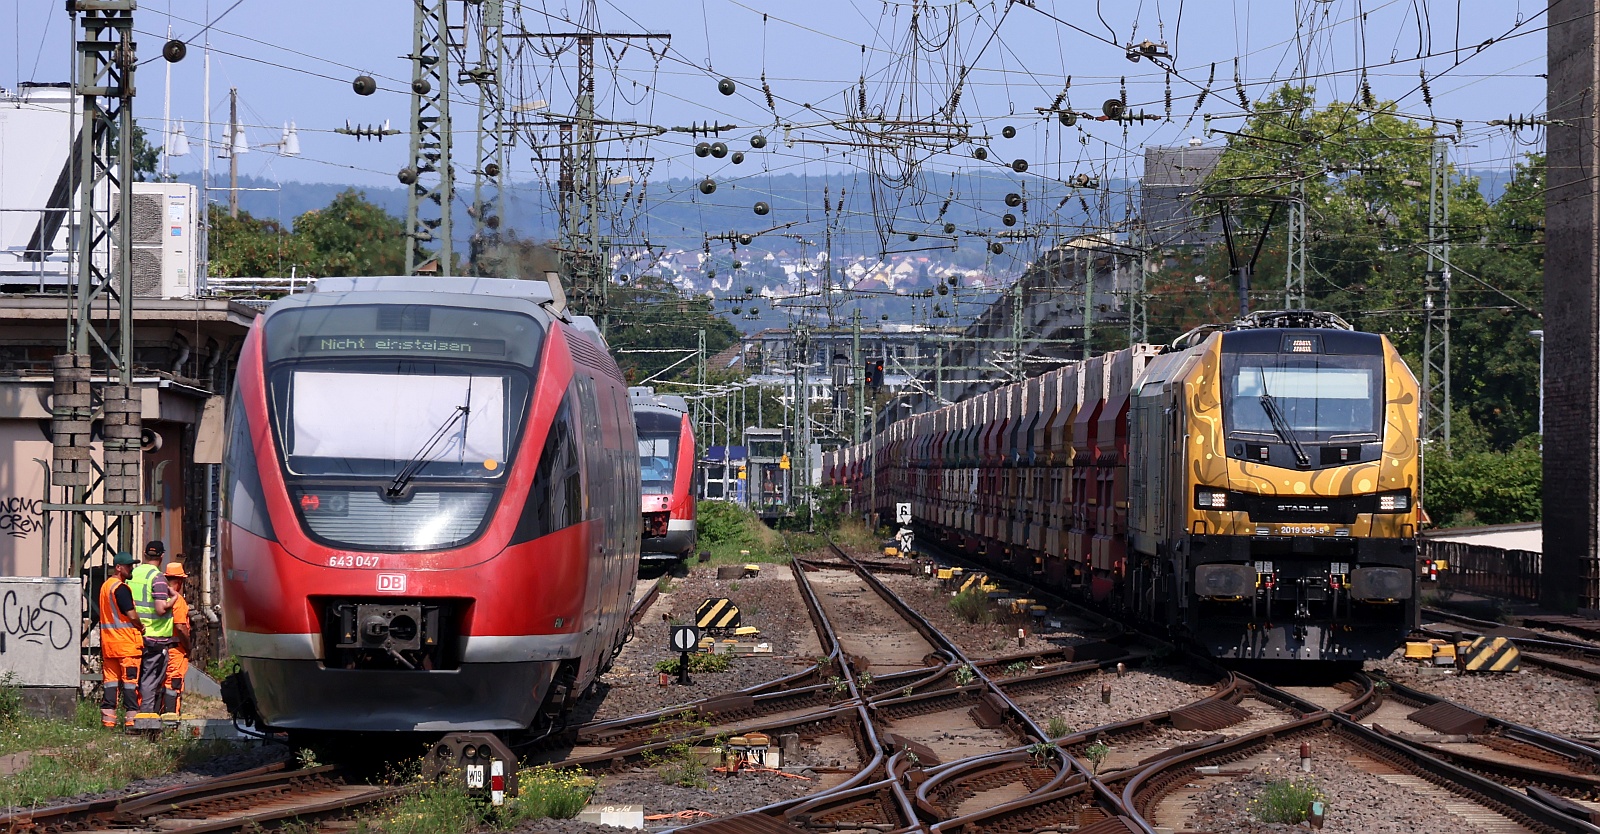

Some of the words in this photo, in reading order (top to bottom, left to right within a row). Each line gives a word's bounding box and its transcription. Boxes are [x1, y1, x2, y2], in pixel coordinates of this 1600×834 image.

[321, 338, 365, 350] Nicht
[1281, 526, 1300, 534] 2019
[329, 556, 353, 567] 643
[355, 556, 379, 567] 047
[379, 575, 403, 590] DB
[468, 770, 482, 783] W19
